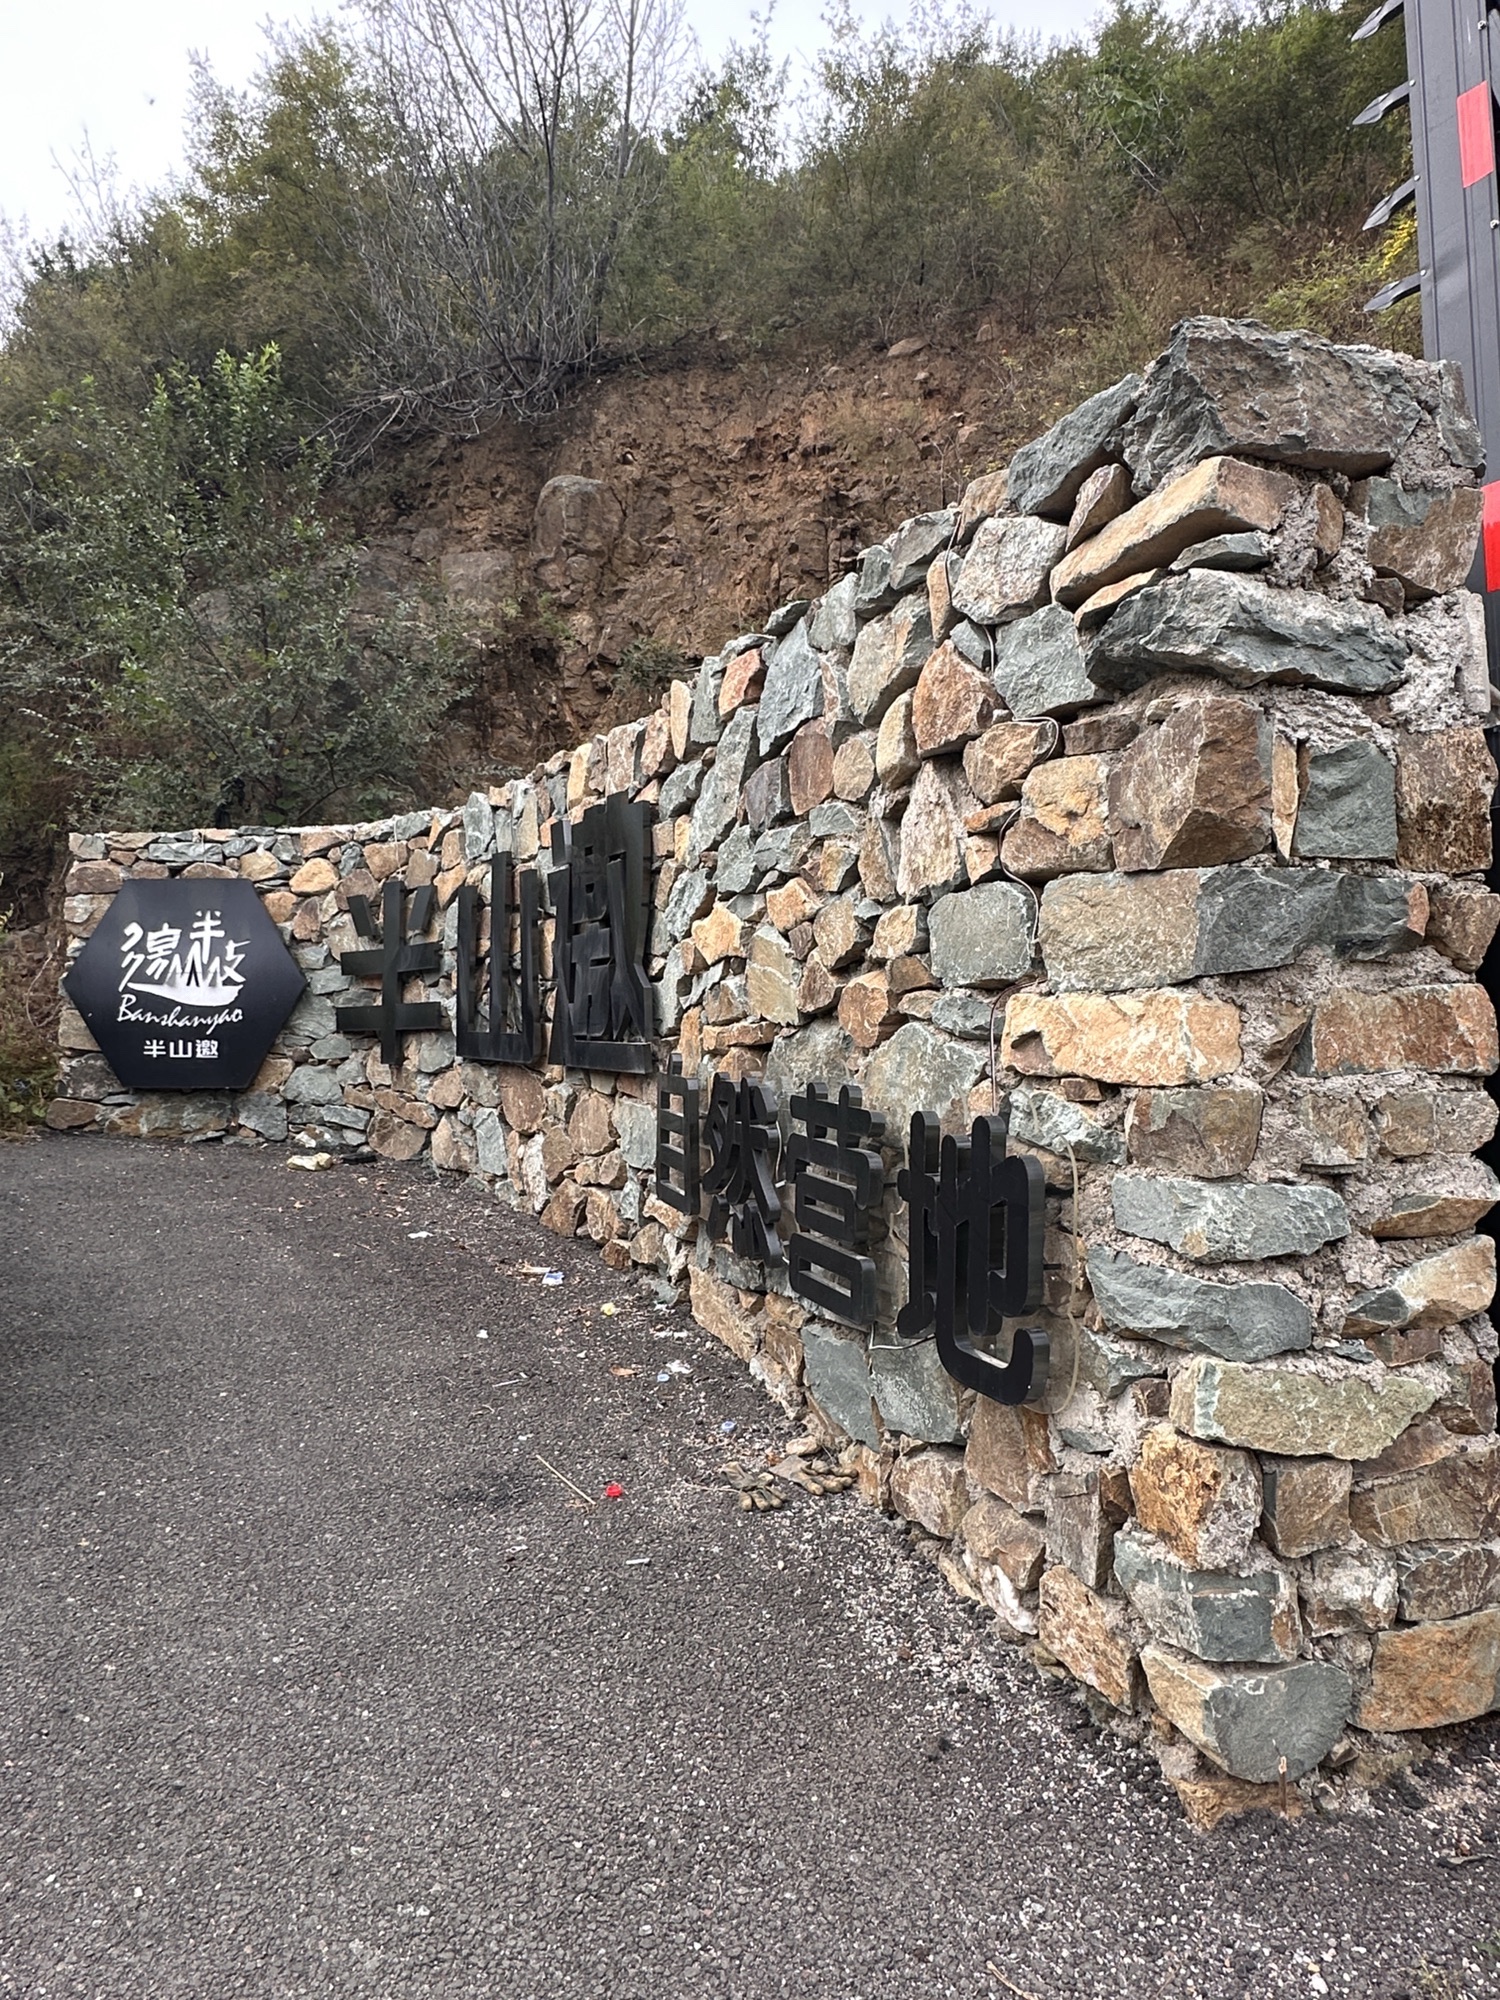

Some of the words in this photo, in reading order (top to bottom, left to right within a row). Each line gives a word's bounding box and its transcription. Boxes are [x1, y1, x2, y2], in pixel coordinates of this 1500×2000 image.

[116, 993, 244, 1035] Banshanyao
[336, 791, 652, 1075] 半山邀
[143, 1039, 219, 1059] 半山邀
[656, 1052, 1050, 1406] 自然营地
